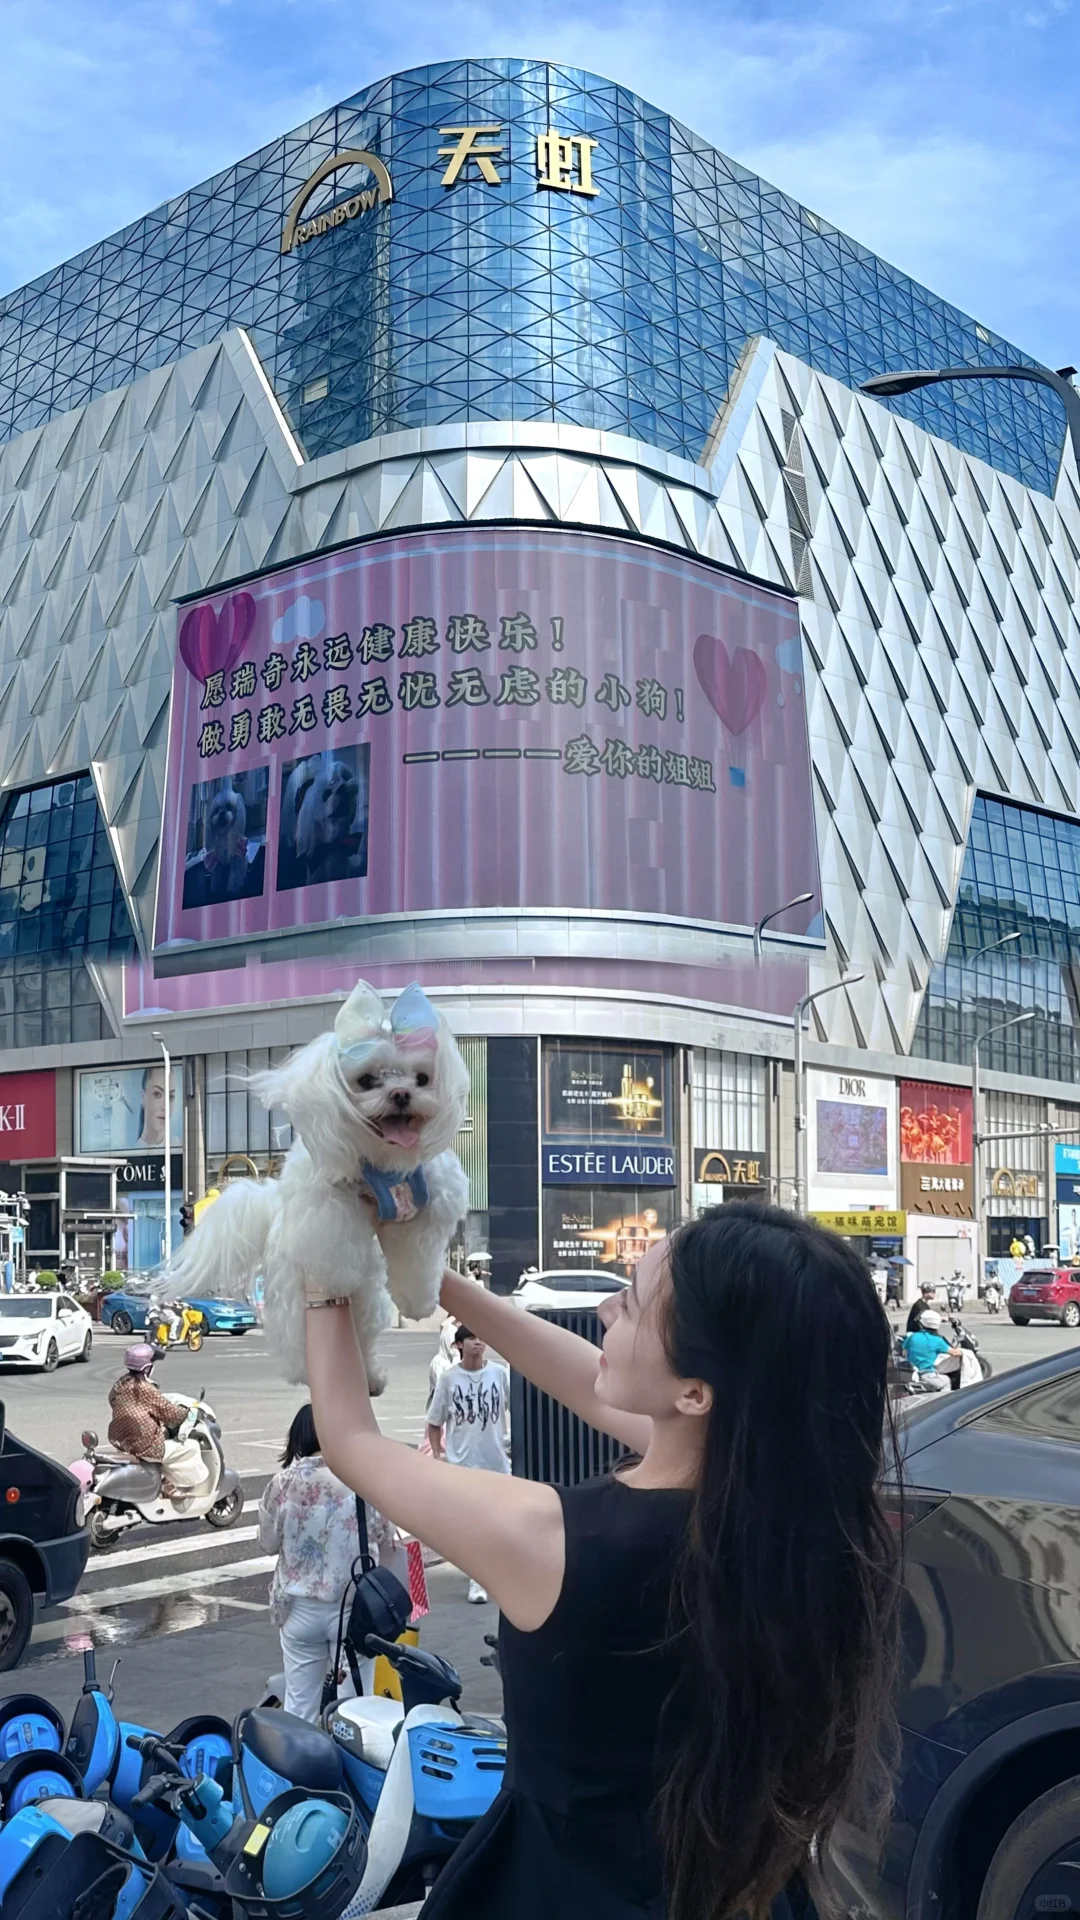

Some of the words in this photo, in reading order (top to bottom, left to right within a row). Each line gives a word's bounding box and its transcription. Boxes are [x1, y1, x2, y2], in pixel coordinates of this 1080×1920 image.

[437, 126, 600, 196] 天虹
[292, 187, 380, 246] RAINBOW
[201, 612, 564, 710] 愿瑞奇永远健康快乐！
[198, 665, 685, 758] 做勇敢无畏无忧无虑的小狗！
[838, 1076, 866, 1097] DIOR
[0, 1104, 26, 1132] K-II
[115, 1162, 156, 1182] CÔME
[612, 1155, 674, 1175] LAUDER
[733, 1159, 760, 1184] 天虹
